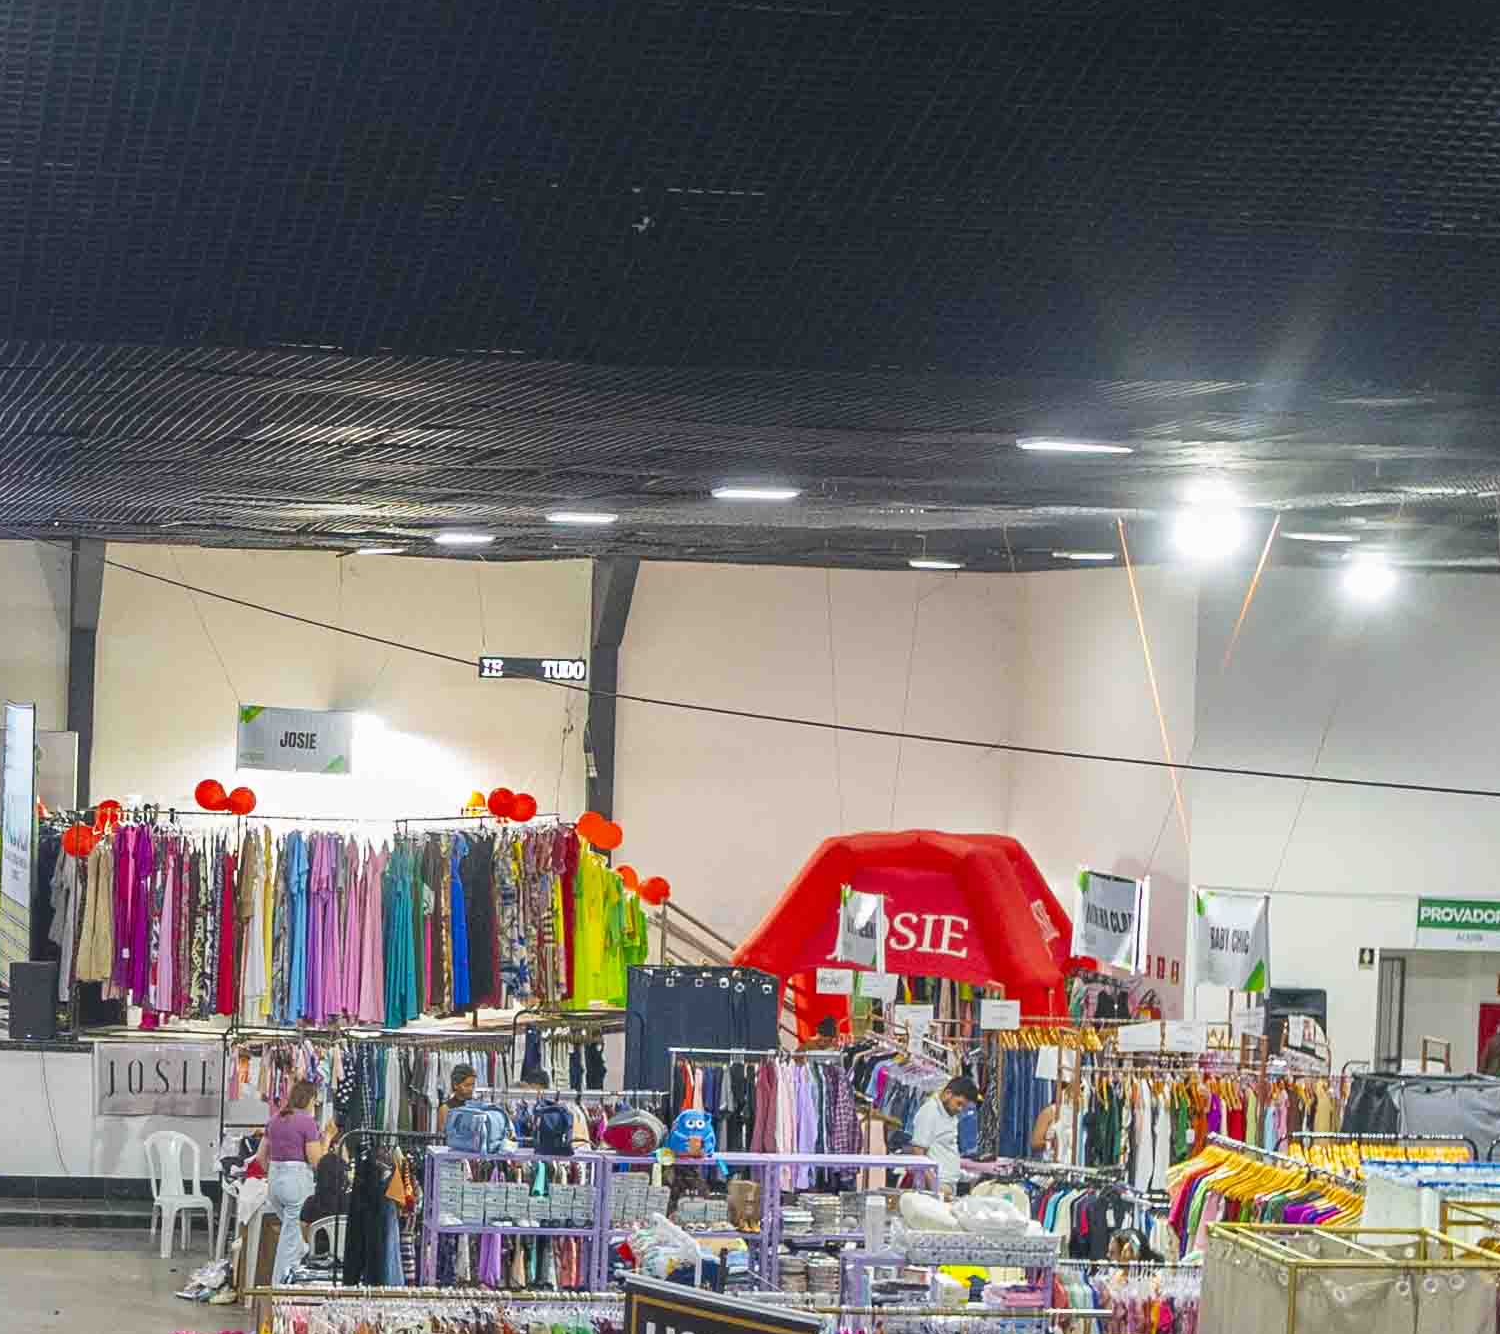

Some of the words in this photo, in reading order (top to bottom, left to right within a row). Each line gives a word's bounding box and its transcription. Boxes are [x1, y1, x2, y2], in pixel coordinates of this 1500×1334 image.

[541, 660, 585, 680] TUDO
[279, 730, 318, 751] JOSIE
[826, 910, 969, 961] SIE
[1209, 926, 1230, 951] BABY
[104, 1058, 218, 1098] JOSIE
